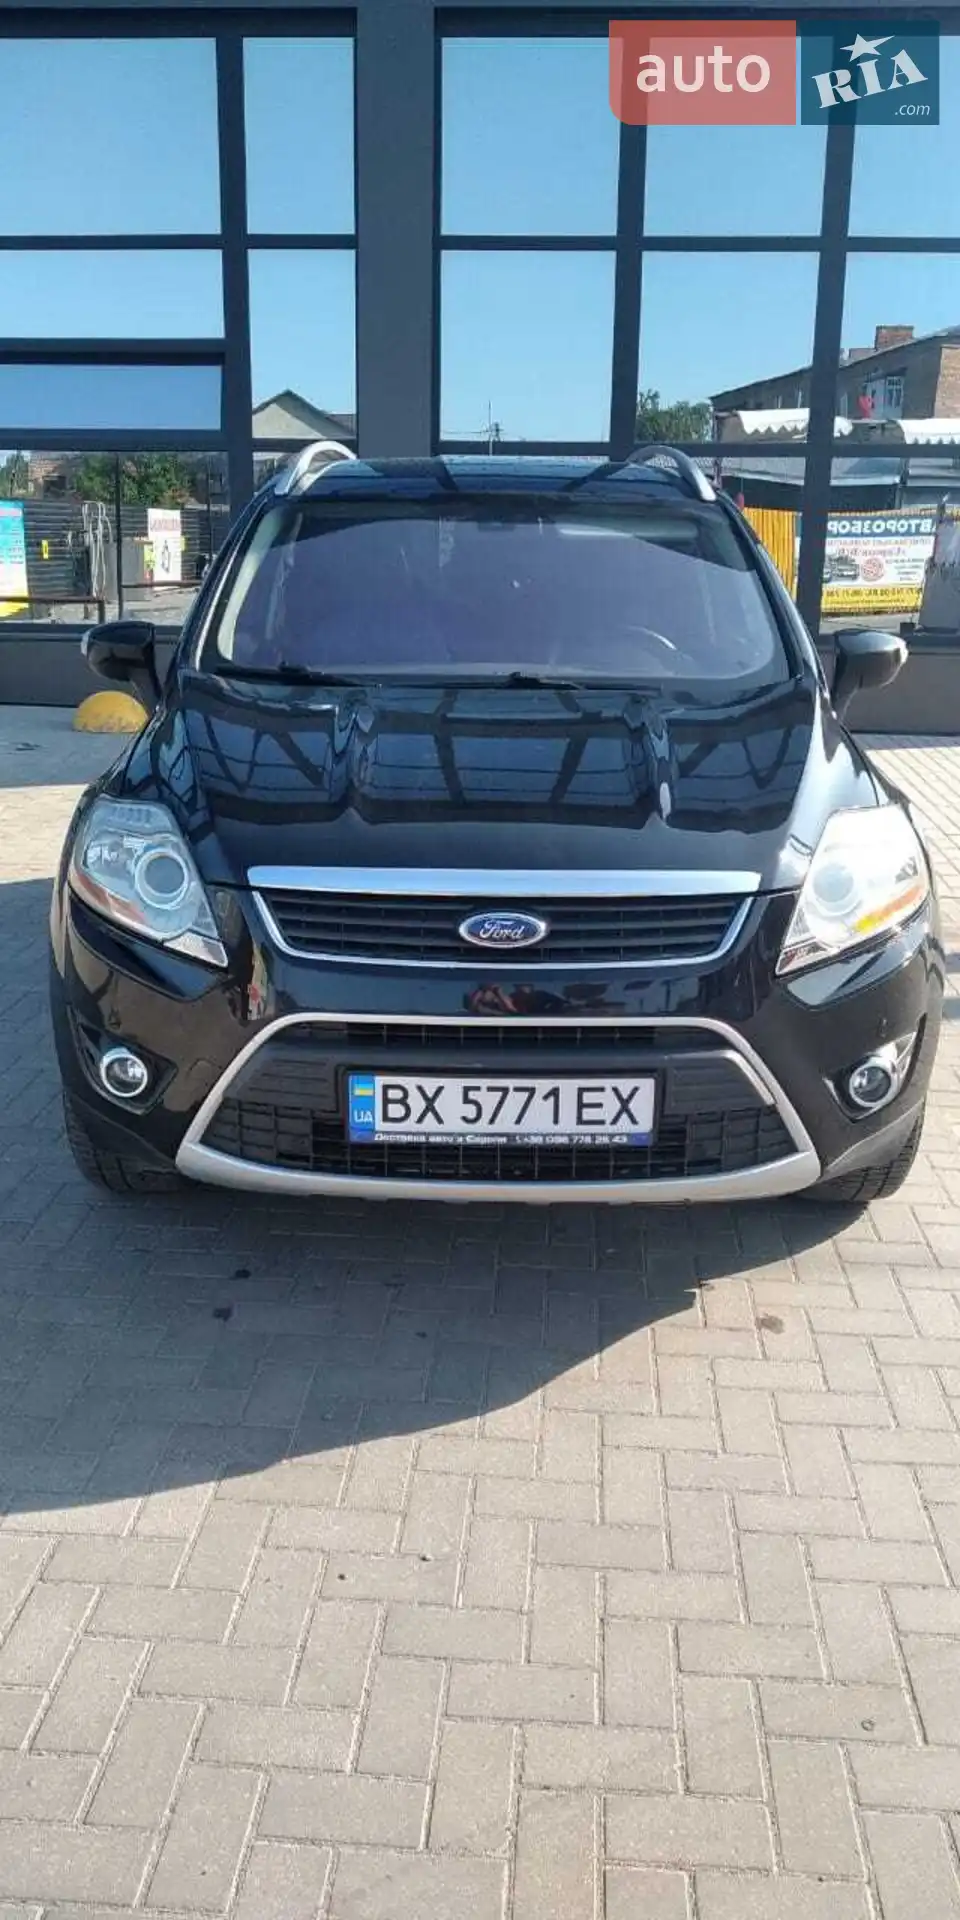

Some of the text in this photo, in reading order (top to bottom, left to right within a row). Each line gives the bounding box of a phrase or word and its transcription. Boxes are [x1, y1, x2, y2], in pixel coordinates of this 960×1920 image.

[479, 918, 525, 939] Ford
[381, 1083, 640, 1126] BX 5771 EX
[354, 1111, 374, 1123] UA
